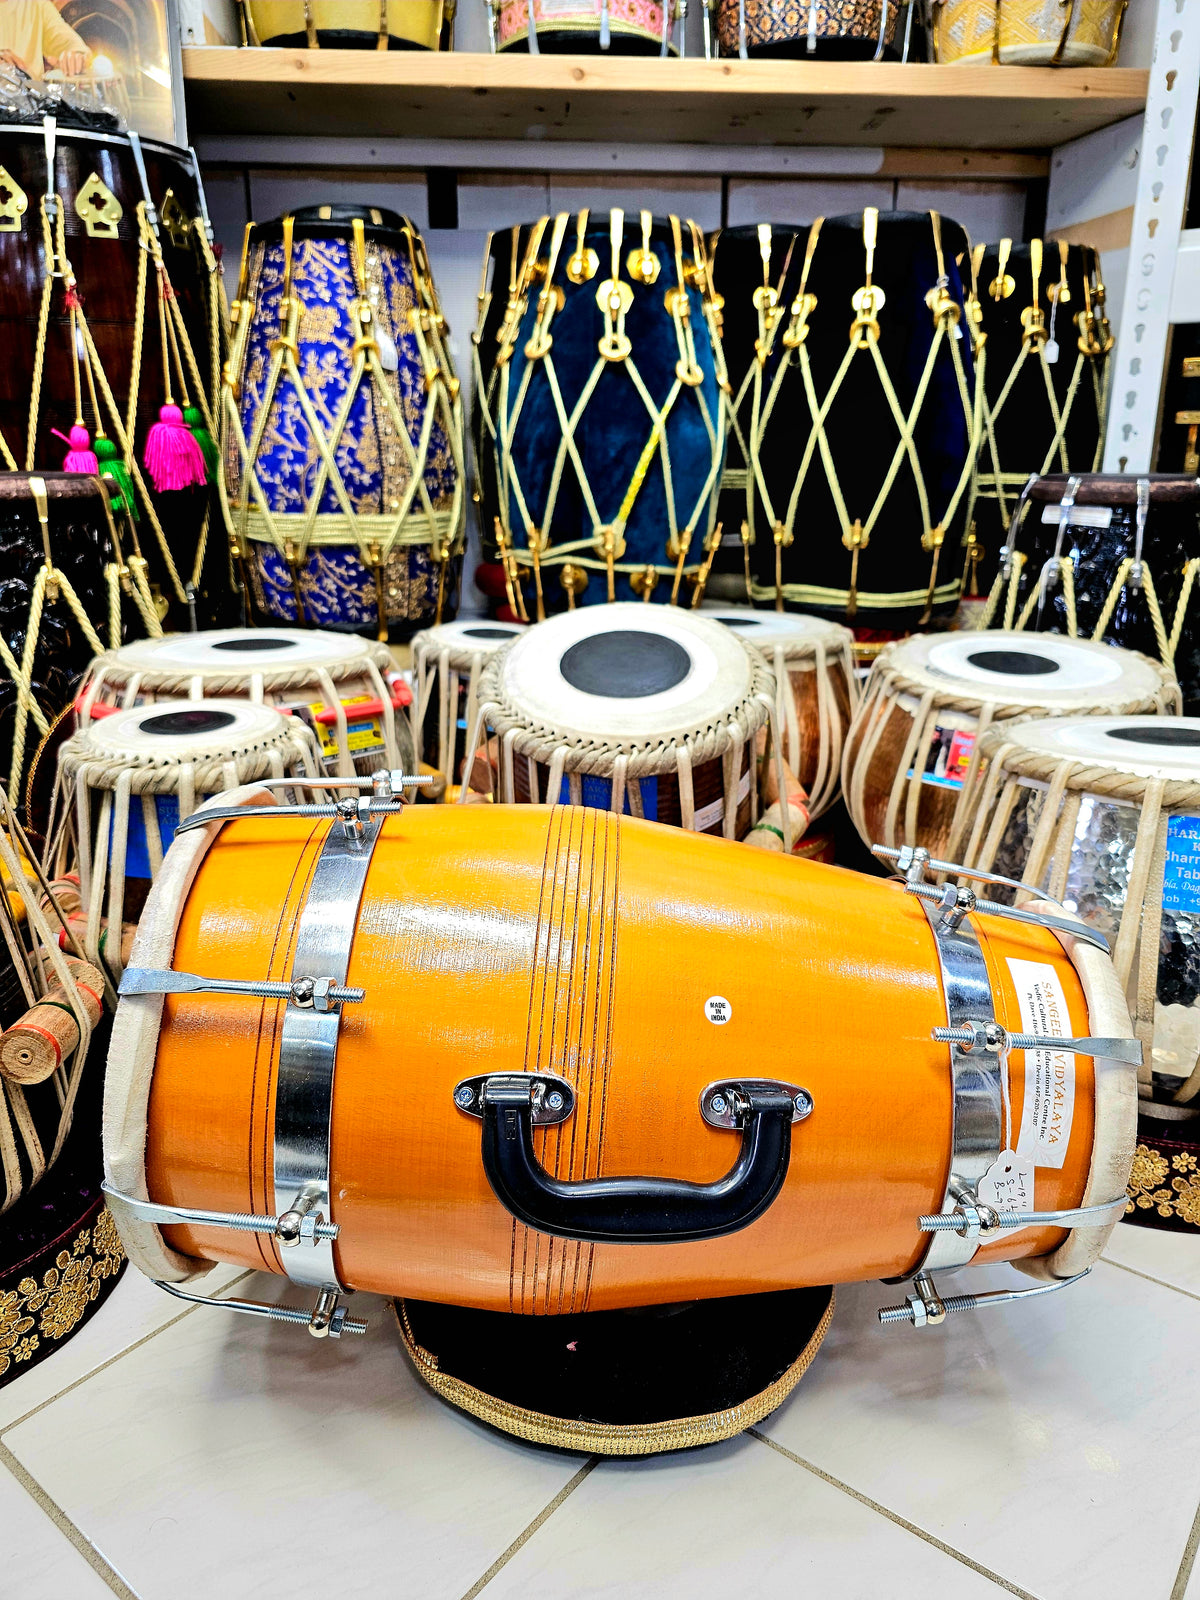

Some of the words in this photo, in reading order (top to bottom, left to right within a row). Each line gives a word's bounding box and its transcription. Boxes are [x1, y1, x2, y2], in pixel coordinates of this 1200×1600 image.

[1034, 983, 1043, 1002] Vedic
[1038, 1003, 1050, 1034] Cultural
[1044, 1051, 1052, 1097] Educational
[1041, 1098, 1051, 1125] Centre
[1048, 1053, 1066, 1144] VIDYALAYA
